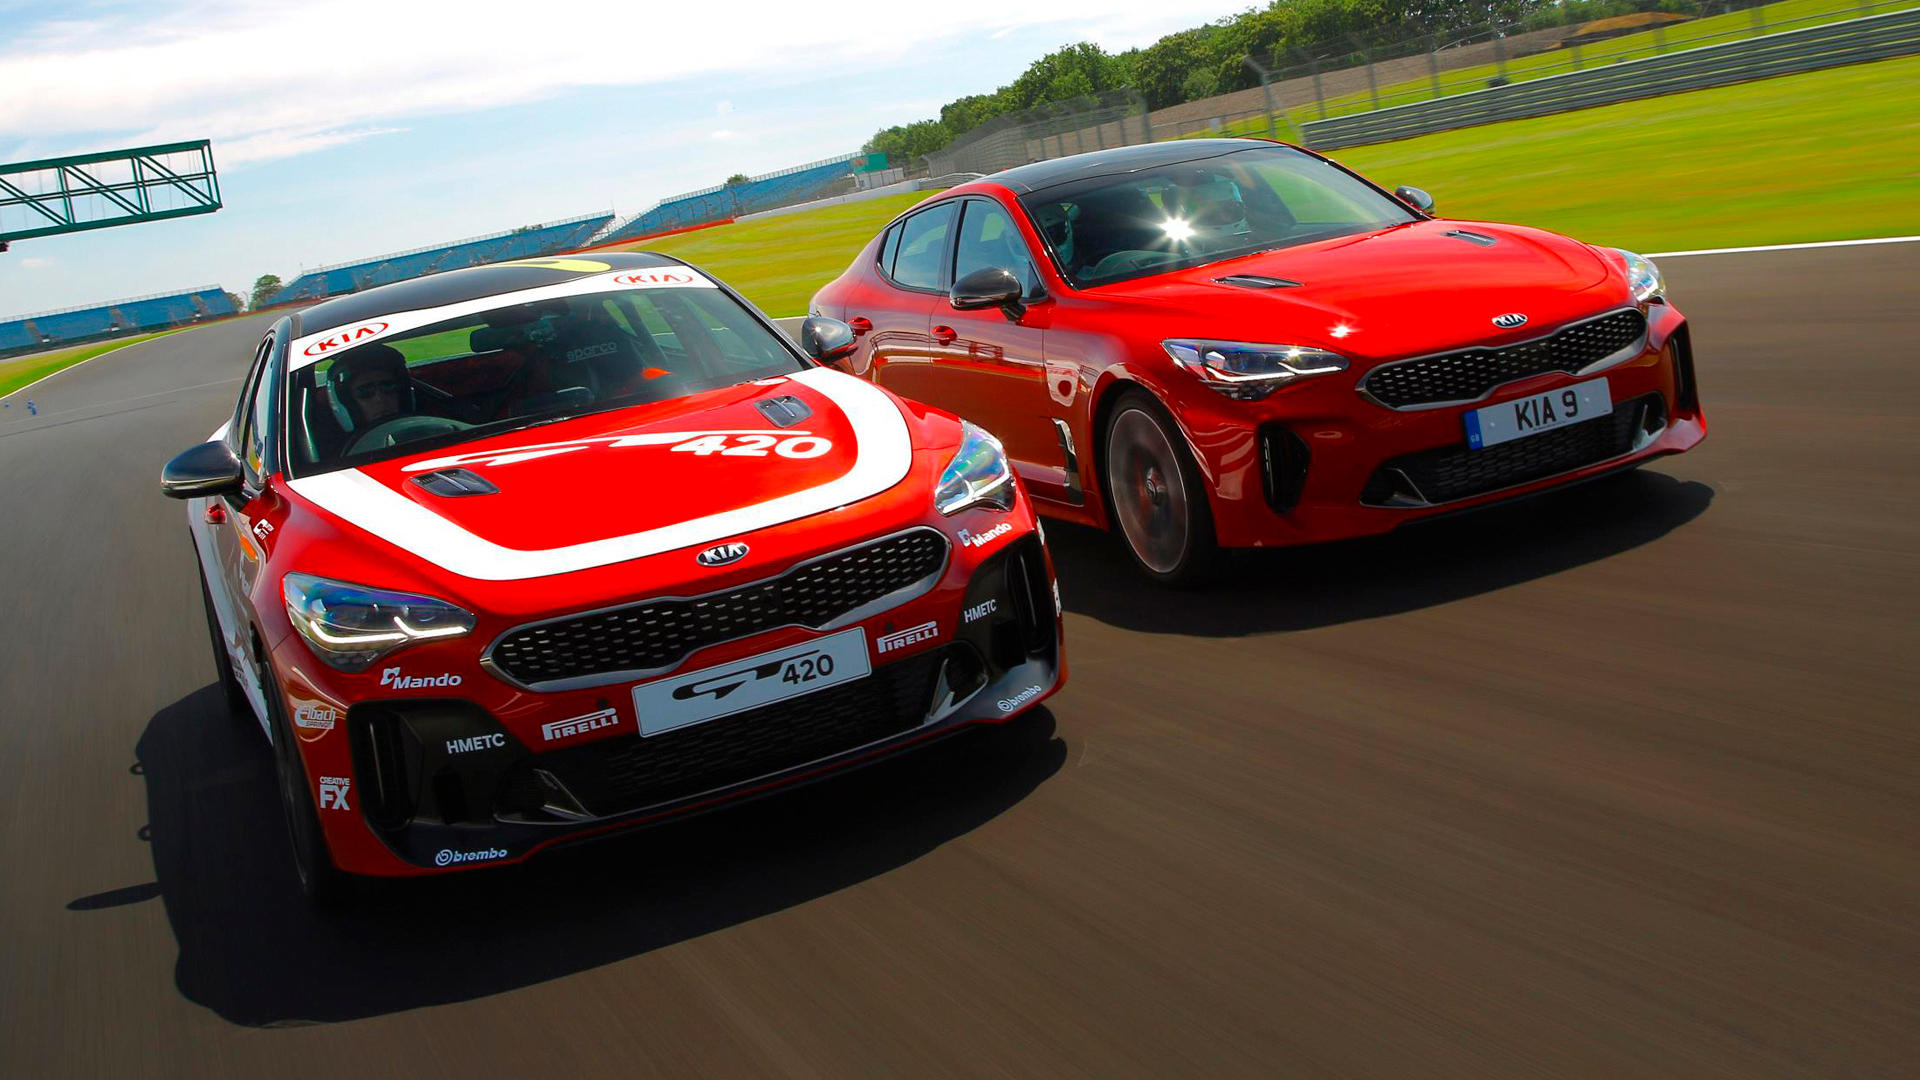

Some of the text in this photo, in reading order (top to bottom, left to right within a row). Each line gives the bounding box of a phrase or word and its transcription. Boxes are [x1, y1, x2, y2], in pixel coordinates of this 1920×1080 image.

[626, 274, 678, 284] KIA
[1500, 314, 1524, 325] KIA
[318, 327, 374, 352] KIA
[567, 341, 617, 362] sparco
[1514, 397, 1557, 430] KIA
[1562, 389, 1579, 417] 9
[971, 522, 1012, 547] Mando
[702, 545, 744, 563] KIA
[964, 599, 997, 623] HMETC
[877, 621, 939, 653] PIRELLI
[393, 672, 462, 690] Mando
[782, 654, 834, 685] 420
[1009, 684, 1042, 709] brembo
[542, 708, 619, 740] PIRELLI
[446, 733, 506, 754] HMETC
[320, 776, 350, 785] CREATIVE
[320, 784, 350, 811] FX
[452, 848, 507, 862] brembo
